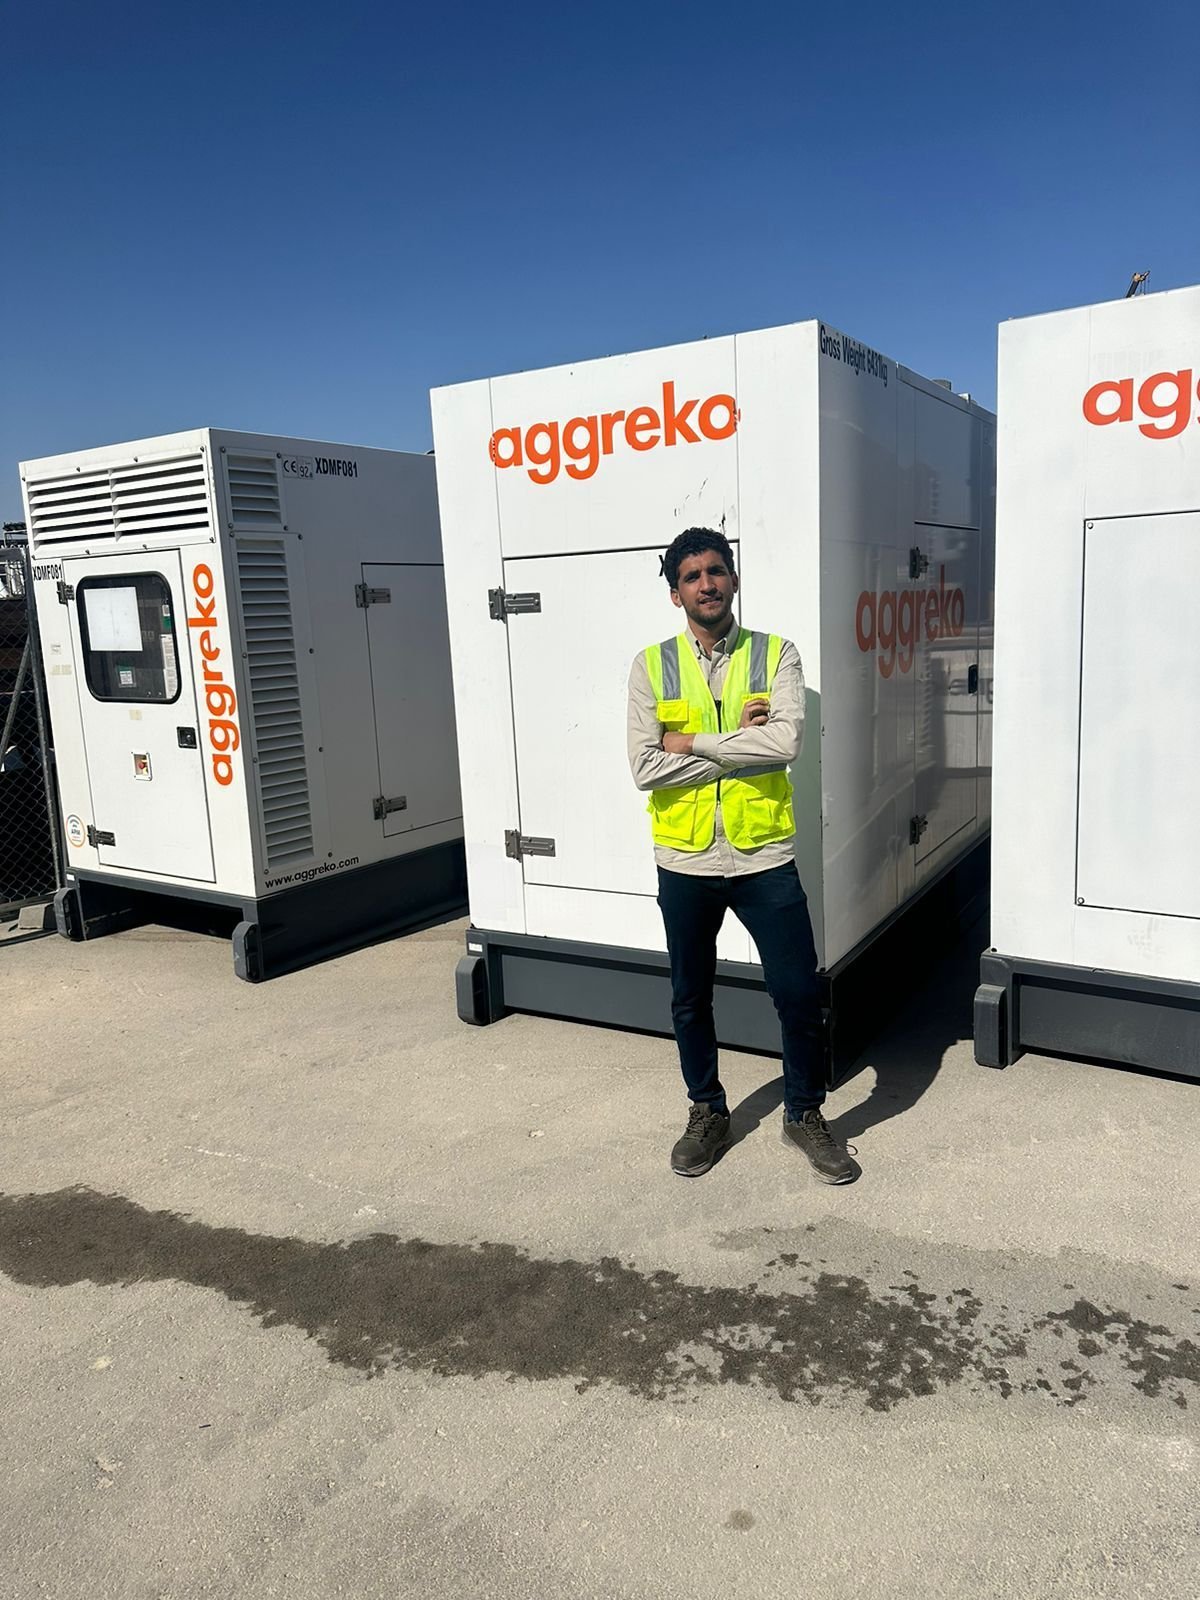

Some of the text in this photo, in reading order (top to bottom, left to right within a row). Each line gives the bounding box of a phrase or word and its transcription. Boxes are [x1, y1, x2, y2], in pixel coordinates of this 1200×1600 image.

[820, 324, 841, 361] Gross
[842, 335, 866, 376] Weight
[489, 380, 741, 485] aggreko
[1082, 368, 1200, 440] ag
[314, 456, 358, 478] XDMF081
[32, 563, 63, 581] XDMF081
[856, 563, 965, 680] aggreko
[187, 563, 240, 786] aggreko
[264, 856, 360, 889] www.aggreko.com
